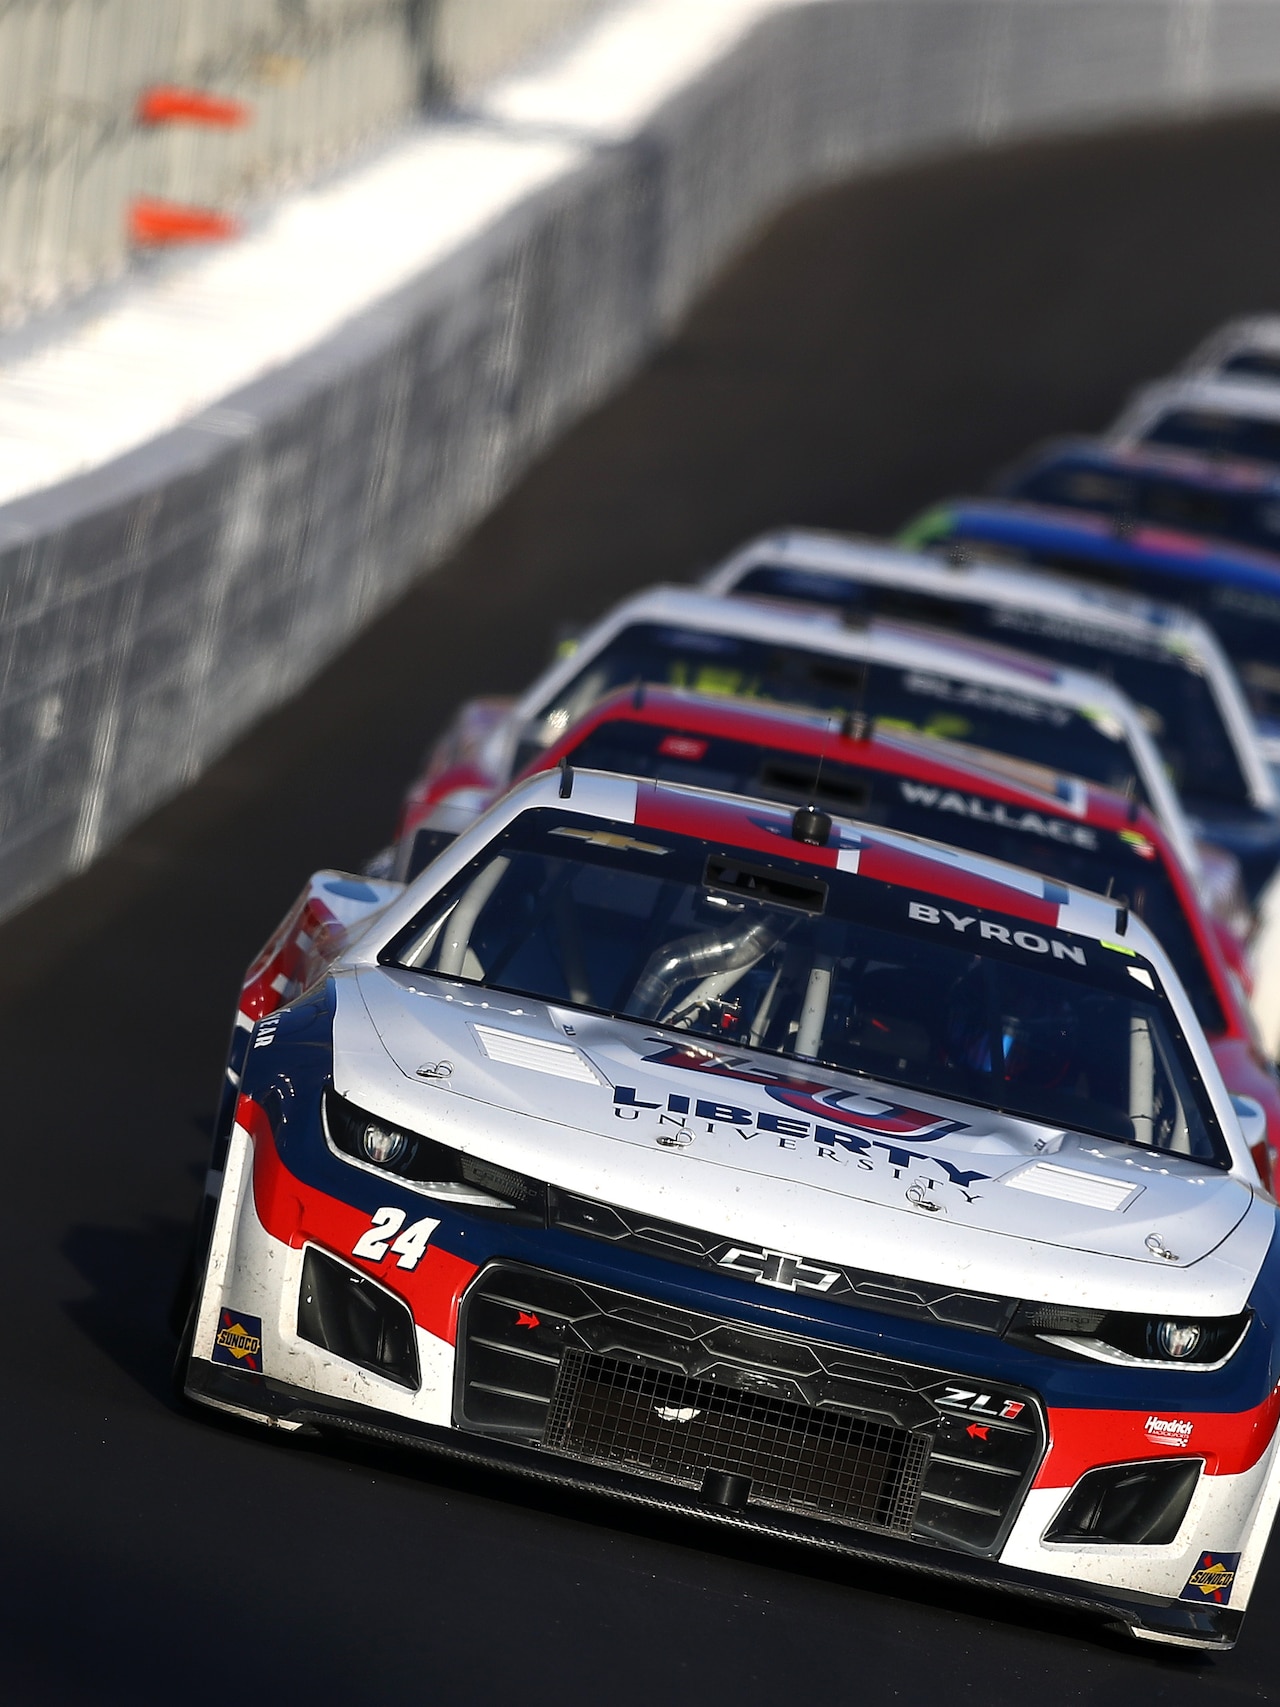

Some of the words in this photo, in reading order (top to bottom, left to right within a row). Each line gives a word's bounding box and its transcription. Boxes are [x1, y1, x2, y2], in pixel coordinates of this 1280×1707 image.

[900, 781, 1098, 851] WALLACE
[908, 901, 1087, 966] BYRON
[613, 1086, 993, 1187] LIBERTY
[613, 1108, 984, 1204] UNIVERSITY
[352, 1206, 442, 1271] 24
[218, 1330, 259, 1353] SUNOCO
[934, 1387, 1026, 1420] ZL1
[1144, 1416, 1193, 1434] Hendrick
[1190, 1571, 1233, 1587] SUNOCO
